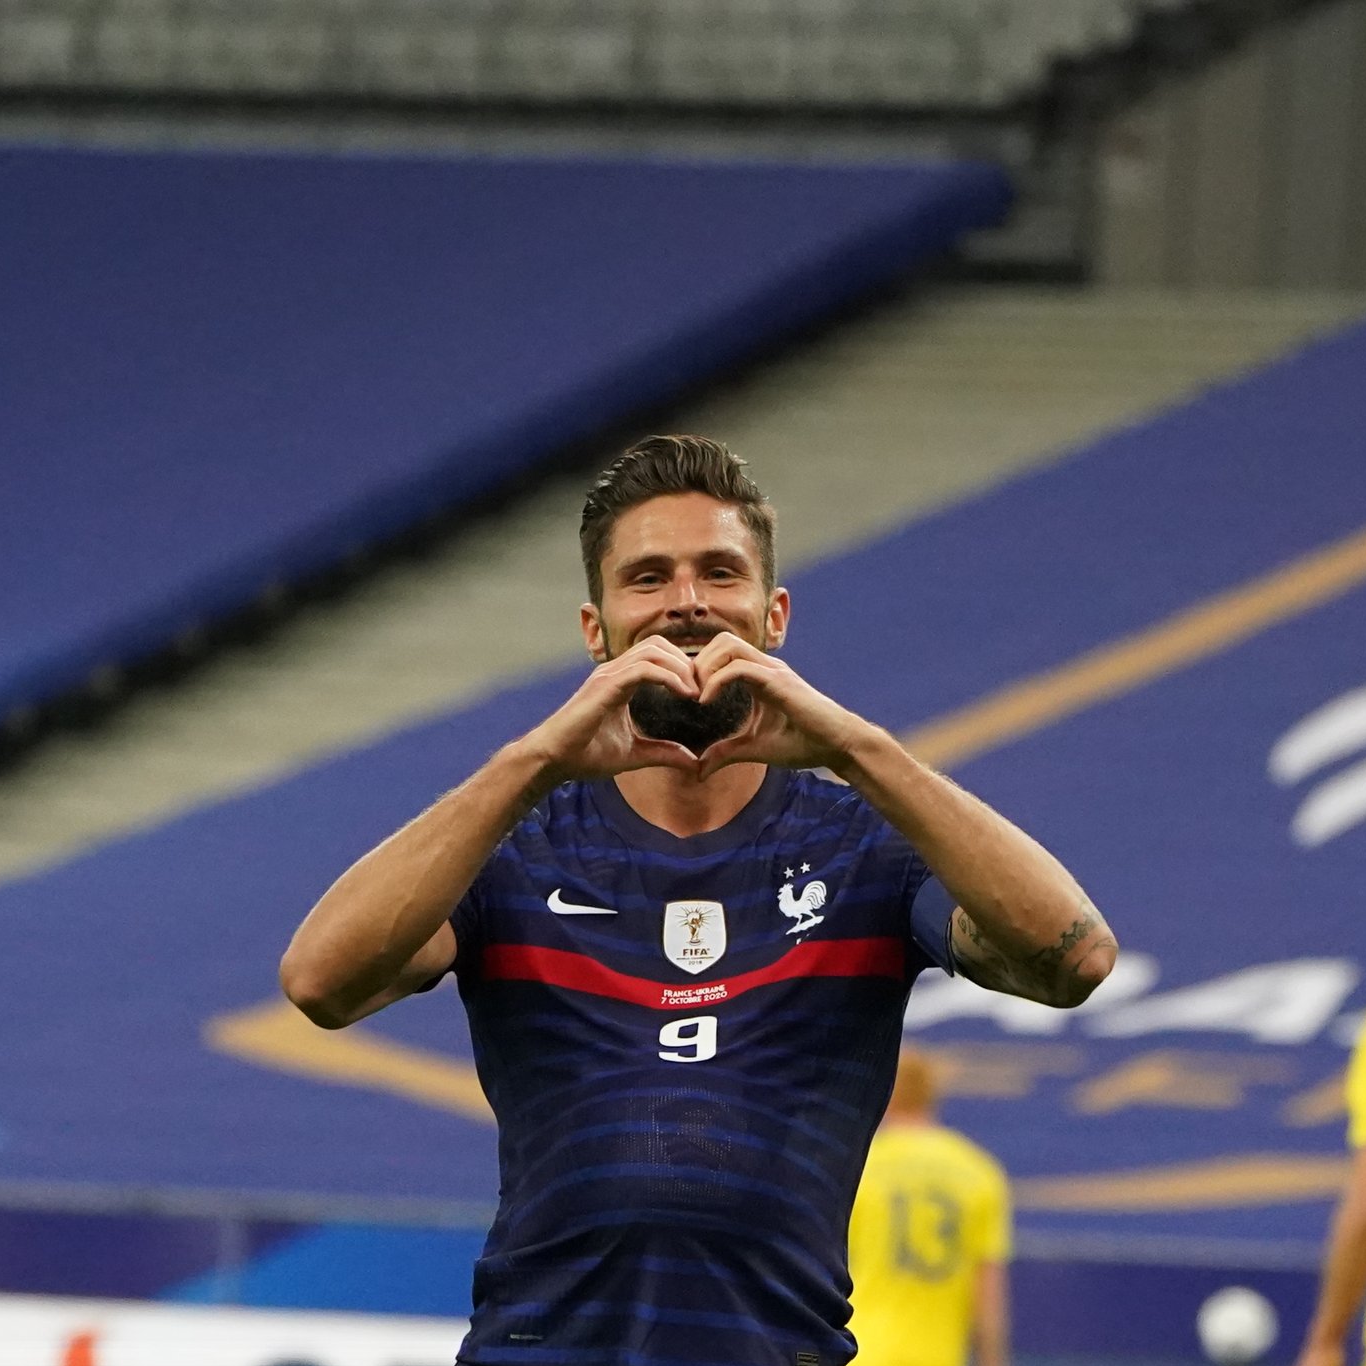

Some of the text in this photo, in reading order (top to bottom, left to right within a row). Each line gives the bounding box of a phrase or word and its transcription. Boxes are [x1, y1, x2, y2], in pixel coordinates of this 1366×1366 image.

[683, 948, 708, 956] FIFA
[663, 984, 726, 997] FRANCE-UKRAINE
[668, 996, 702, 1005] OCTOBRE
[703, 991, 728, 1001] 2020
[659, 1016, 718, 1063] 9
[889, 1182, 963, 1284] 13
